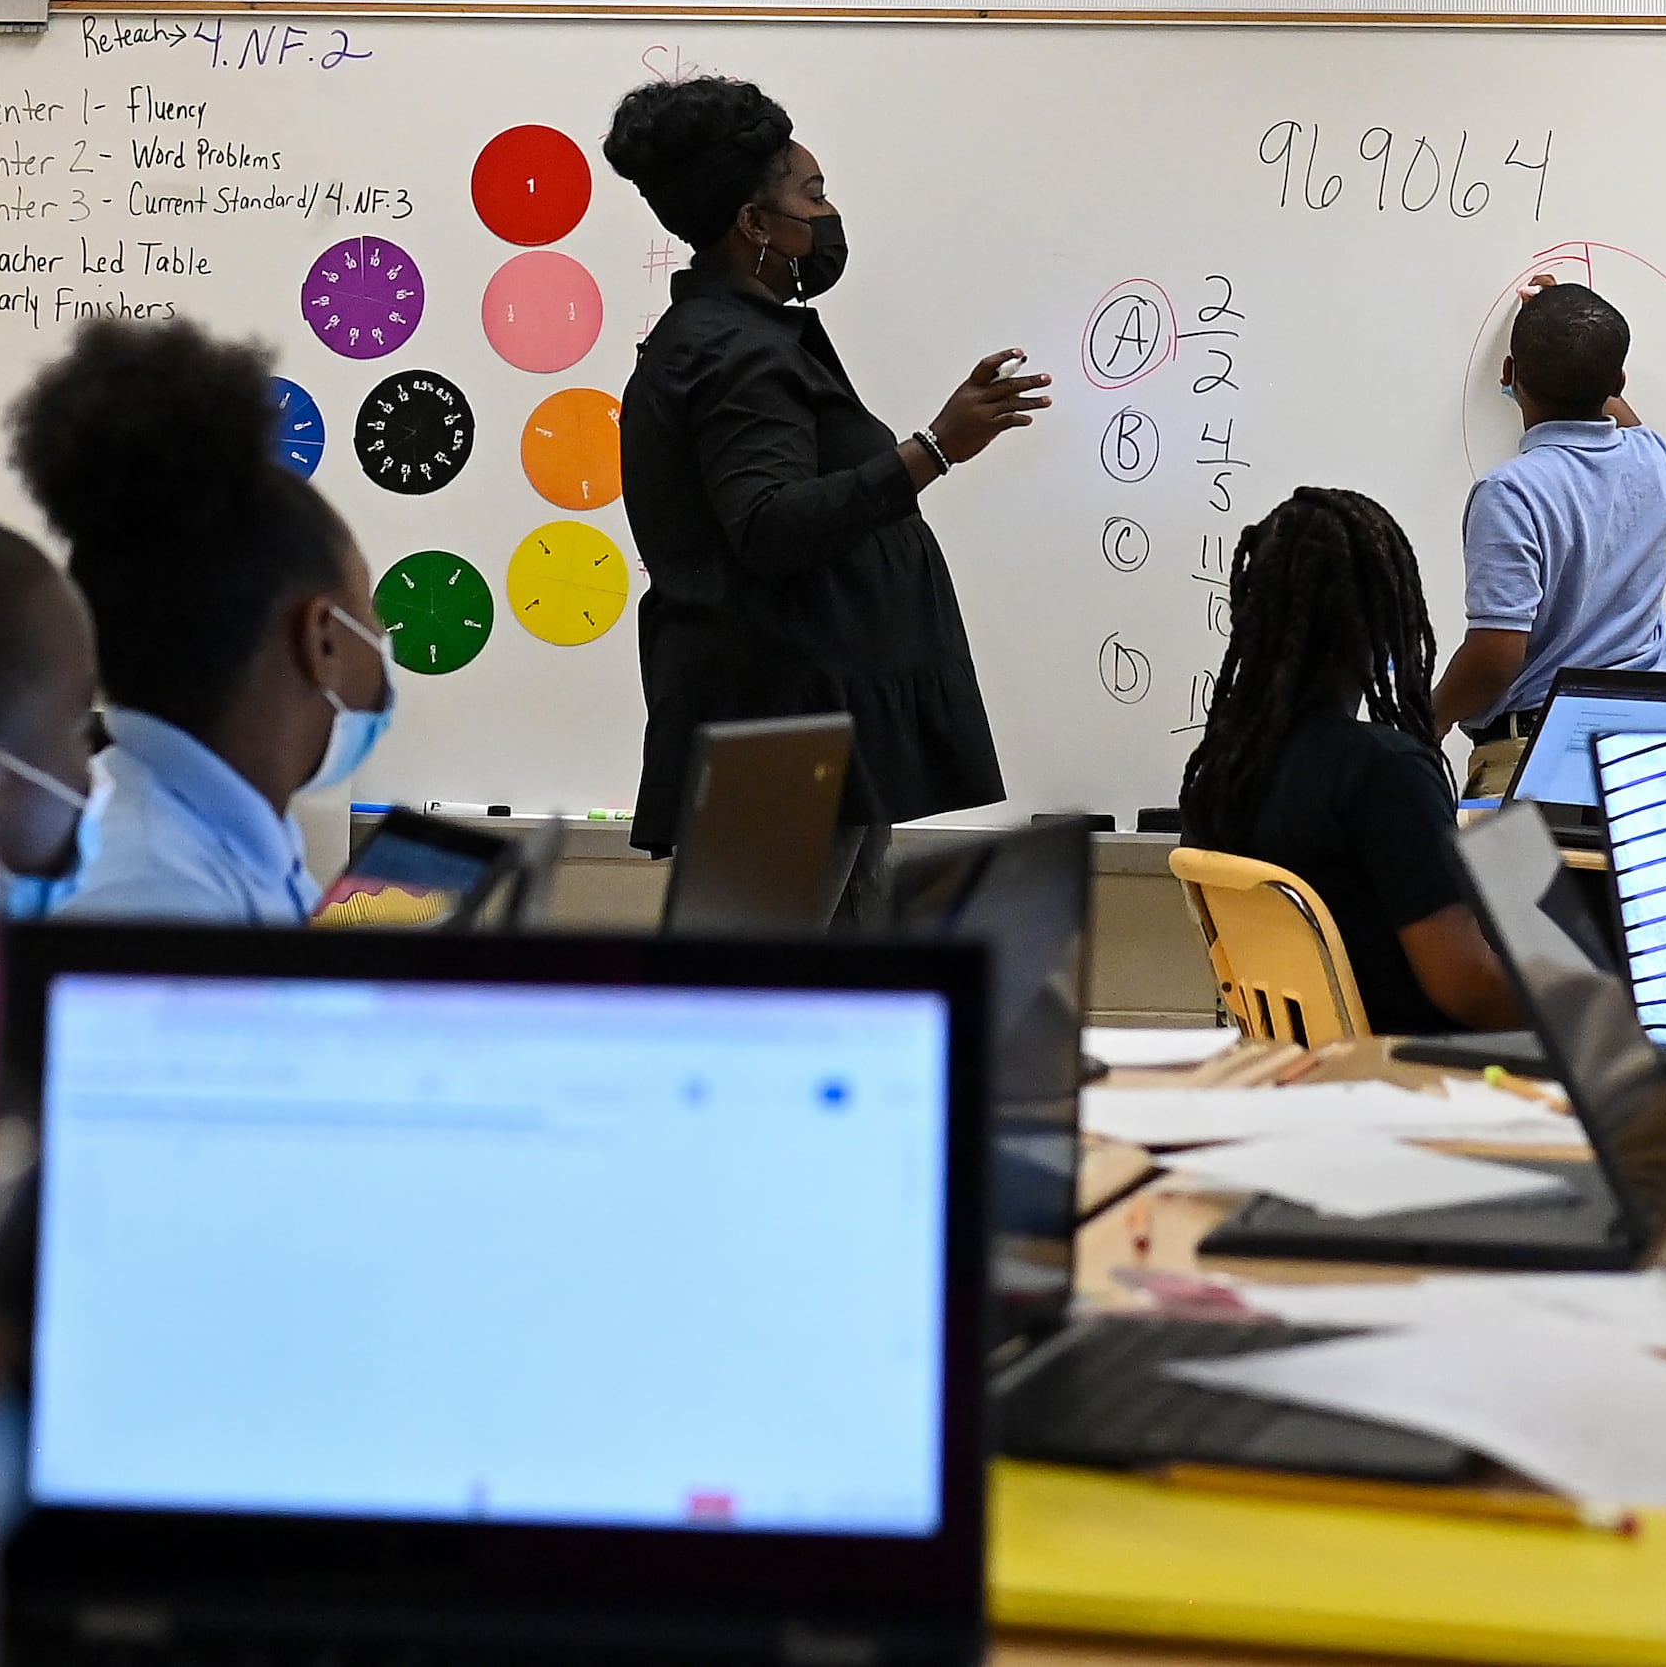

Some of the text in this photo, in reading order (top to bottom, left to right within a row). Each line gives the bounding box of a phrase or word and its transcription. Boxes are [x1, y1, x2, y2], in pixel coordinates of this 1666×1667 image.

[82, 16, 373, 70] Reteach 4.NF.2
[126, 86, 210, 129] Fluency
[132, 134, 186, 170] Word
[197, 135, 282, 171] Problems
[1259, 120, 1553, 221] 969064
[129, 181, 208, 217] Current
[526, 179, 535, 194] 1
[80, 237, 124, 274] Led
[137, 242, 212, 276] Table
[55, 283, 176, 321] Finishers
[1199, 275, 1245, 322] 2
[1107, 306, 1149, 367] A
[1193, 349, 1239, 393] 2
[1118, 413, 1142, 470] B
[1202, 418, 1233, 463] 4
[1209, 472, 1232, 512] 5
[1115, 526, 1138, 564] C
[1203, 535, 1223, 573] 11
[1113, 642, 1138, 692] D
